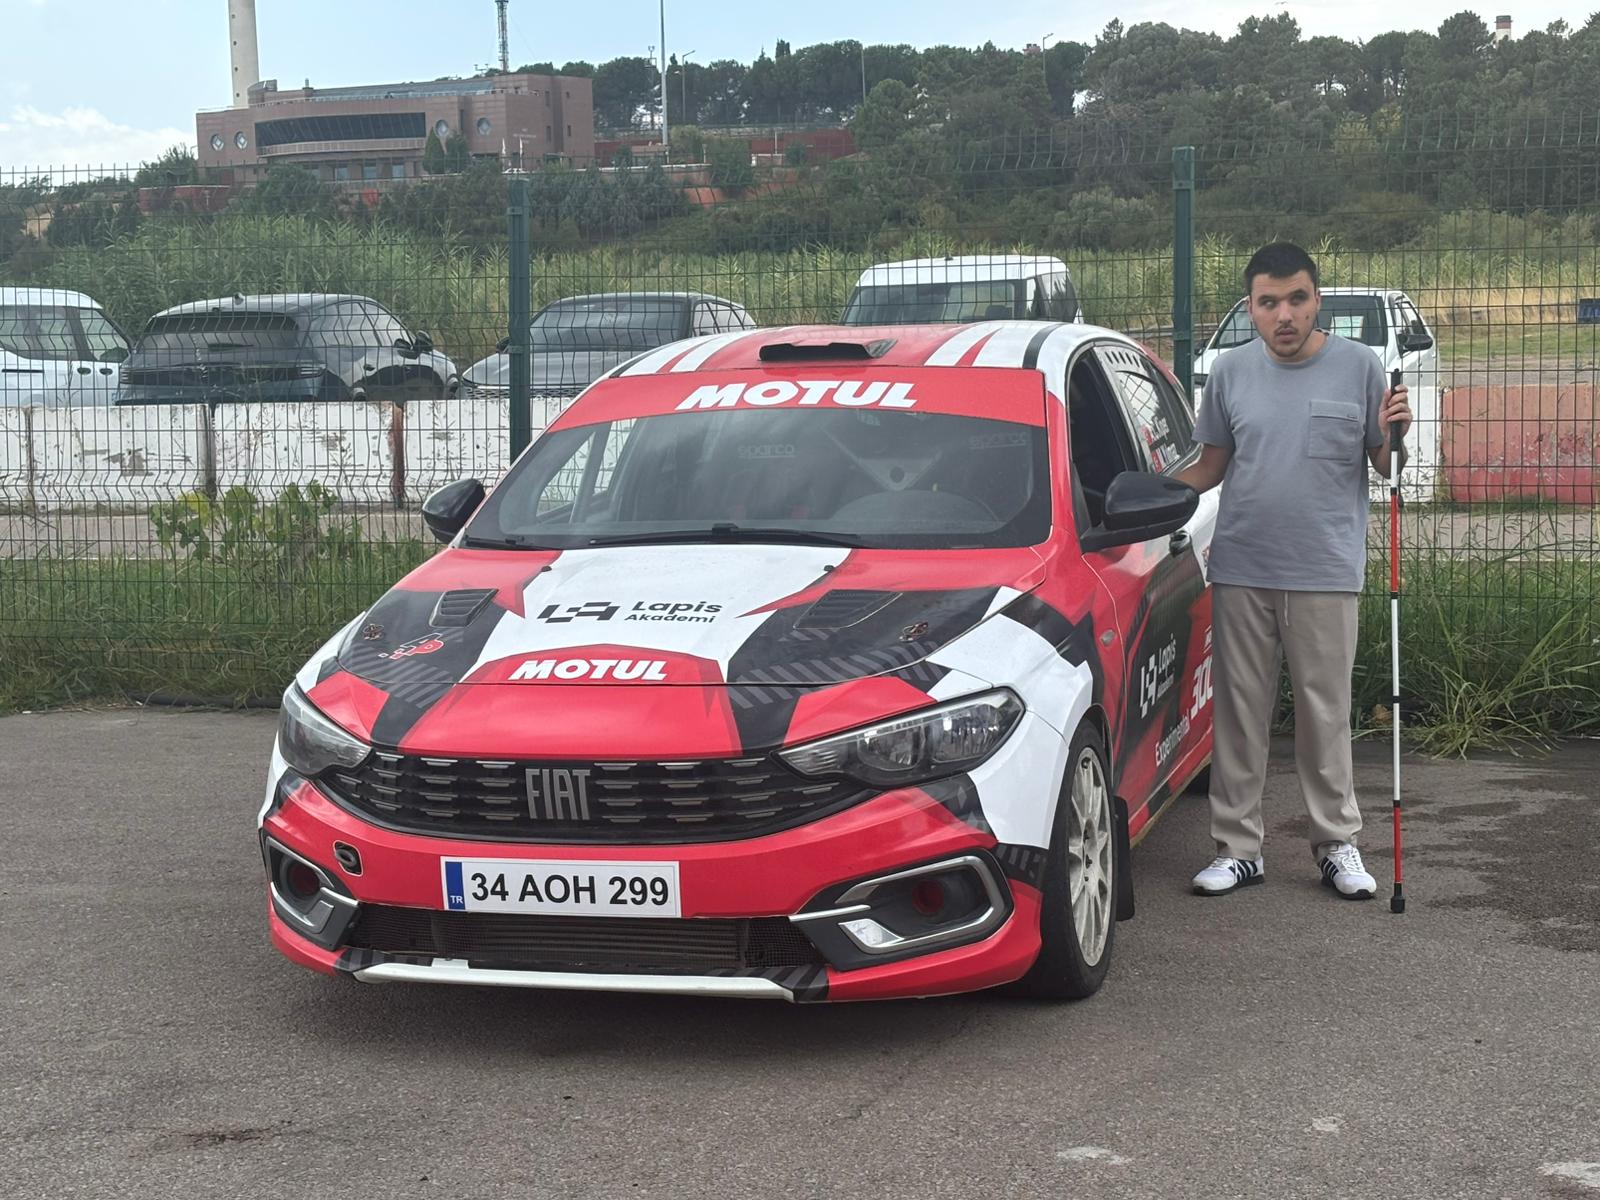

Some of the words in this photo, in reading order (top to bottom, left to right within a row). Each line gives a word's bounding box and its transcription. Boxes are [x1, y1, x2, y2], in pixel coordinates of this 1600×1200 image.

[674, 380, 918, 411] MOTUL
[737, 443, 795, 460] sparco
[632, 601, 723, 616] Lapis
[624, 613, 715, 624] Akademi
[507, 659, 668, 681] MOTUL
[525, 768, 591, 820] FIAT
[470, 872, 509, 902] 34
[518, 874, 596, 904] AOH
[608, 876, 669, 906] 299
[450, 895, 464, 904] TR
